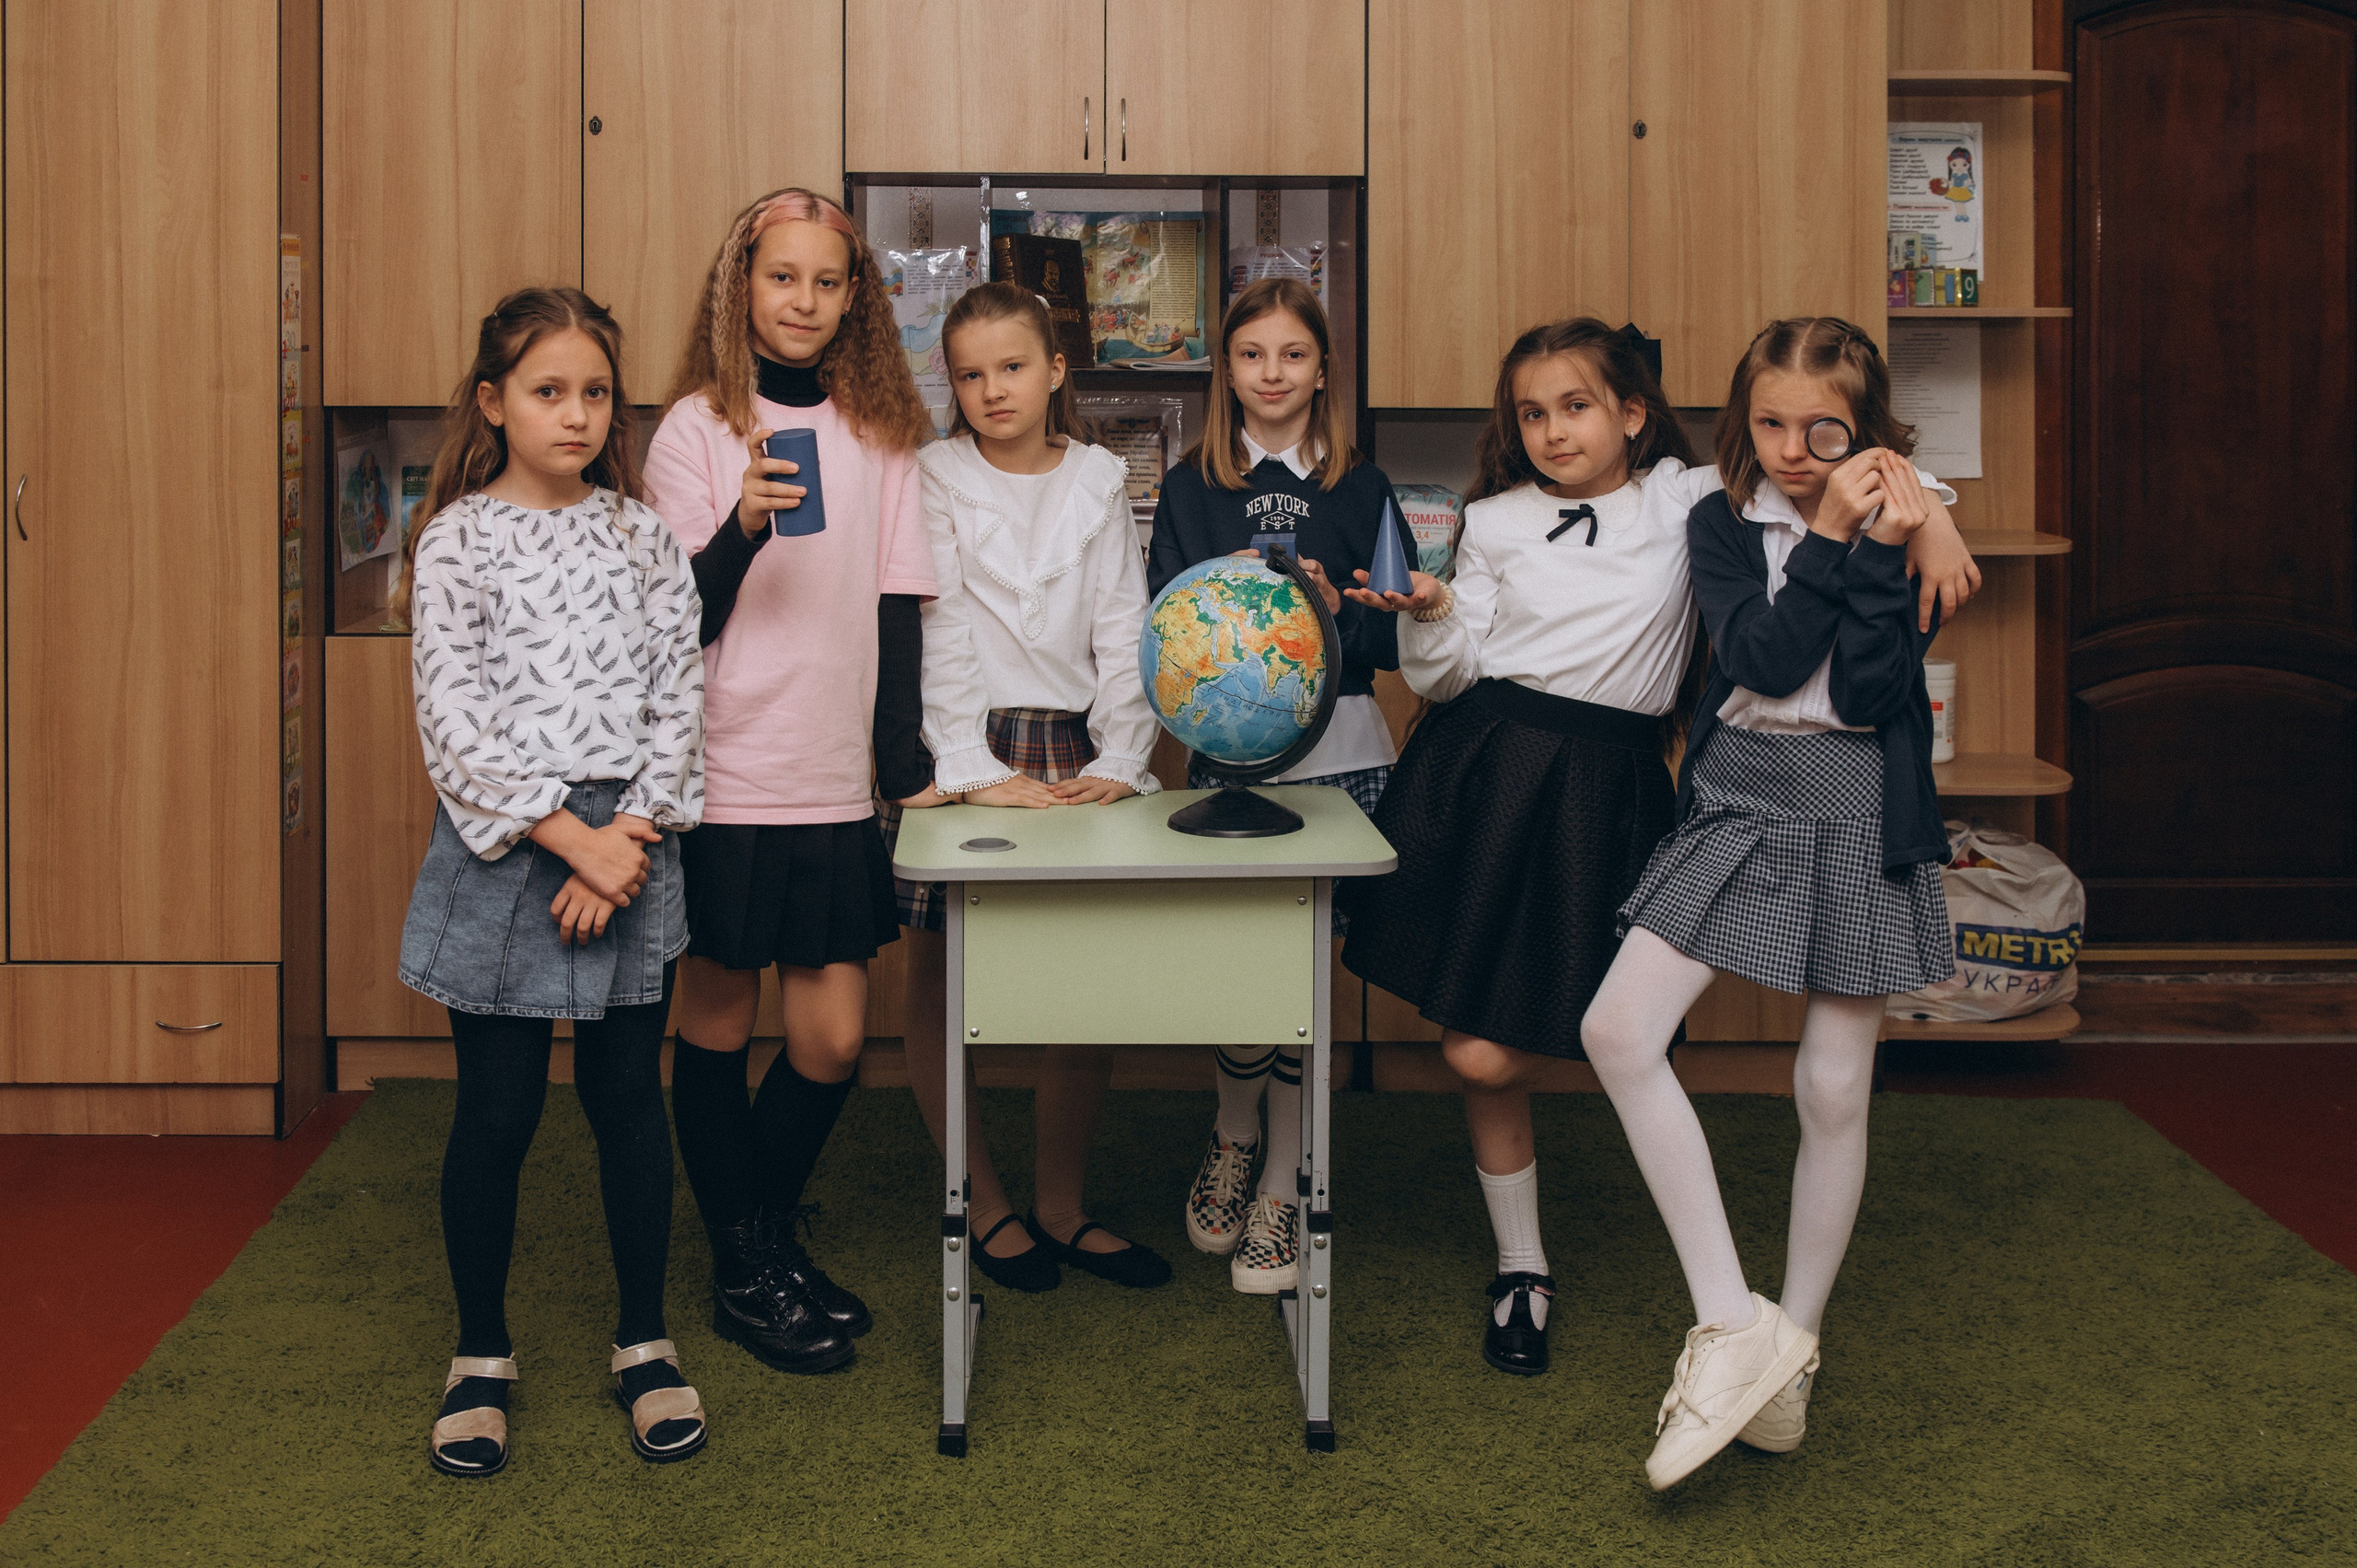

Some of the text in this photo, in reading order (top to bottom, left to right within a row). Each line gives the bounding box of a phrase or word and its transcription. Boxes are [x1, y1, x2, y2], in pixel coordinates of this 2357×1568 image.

[1964, 276, 1975, 299] 9
[1245, 494, 1310, 517] NEW YORK
[1404, 513, 1457, 526] ТОМАТІЯ
[1964, 969, 2059, 994] УКРА
